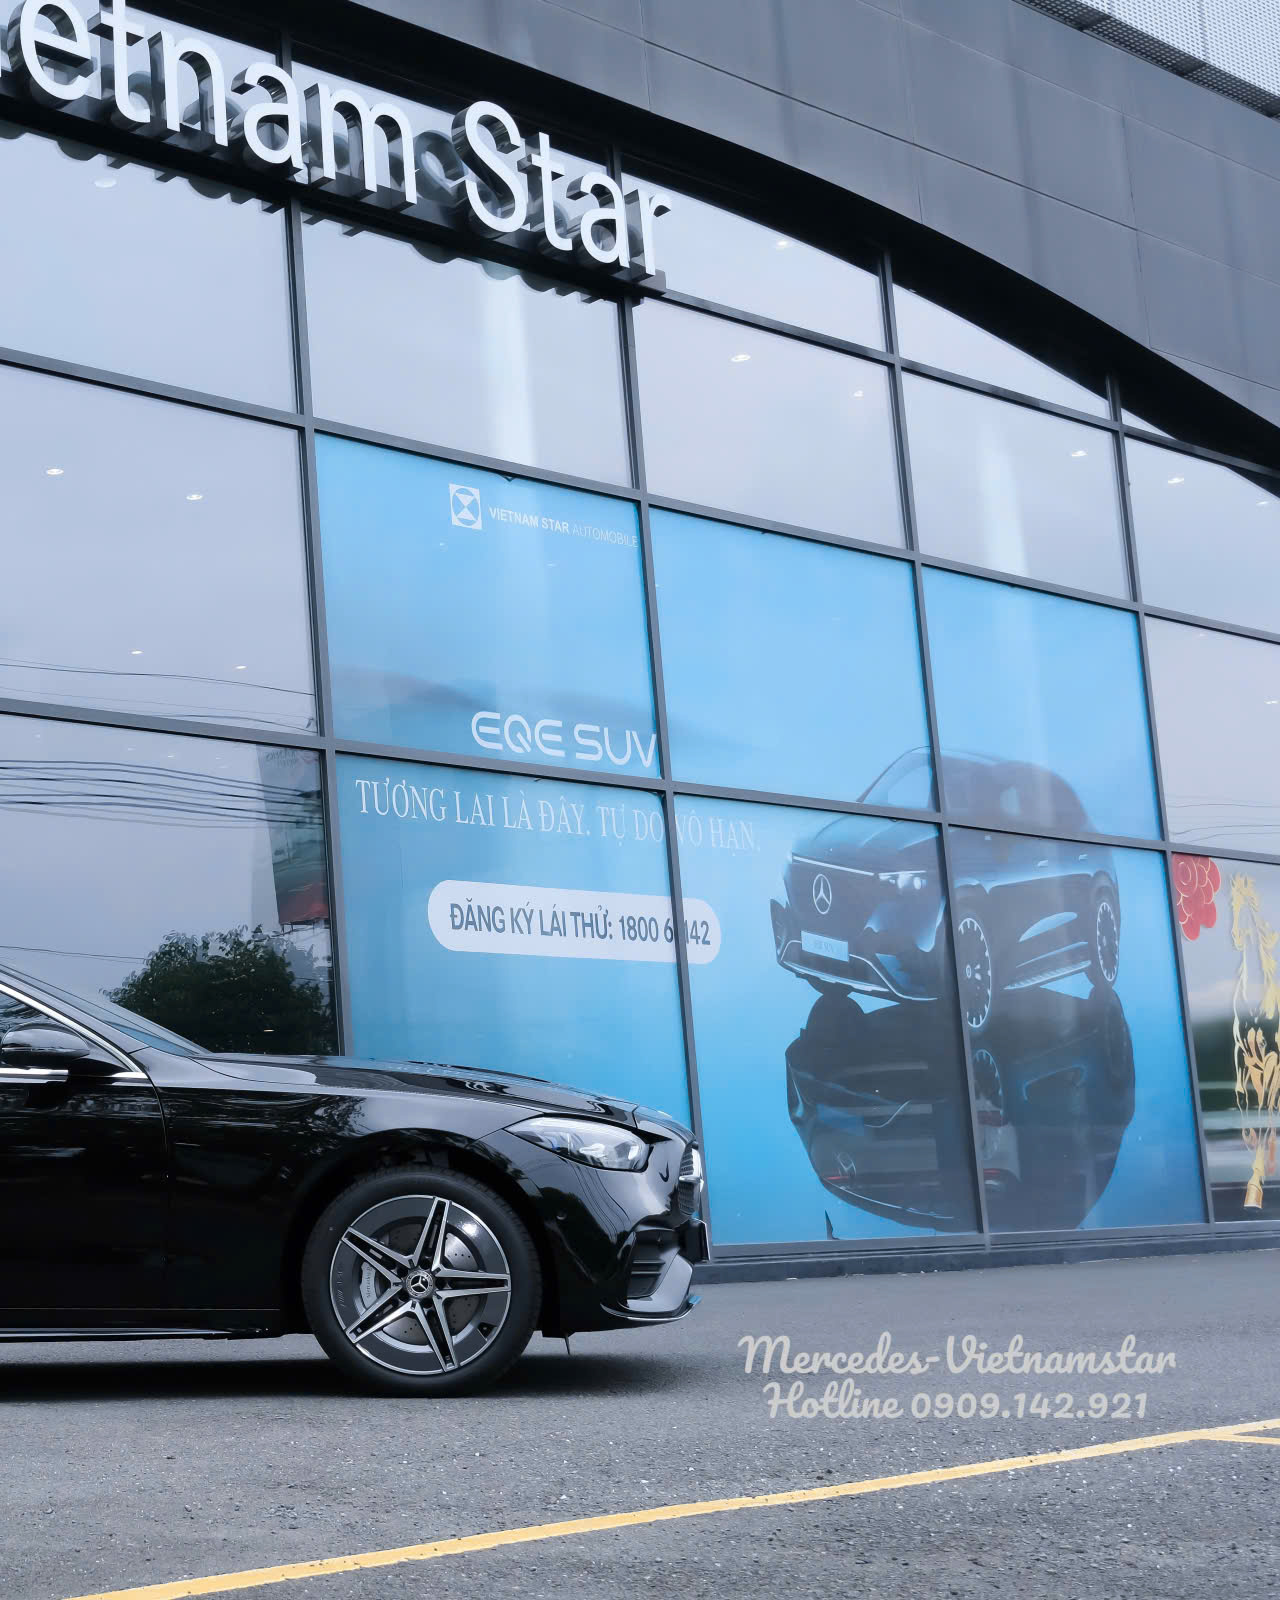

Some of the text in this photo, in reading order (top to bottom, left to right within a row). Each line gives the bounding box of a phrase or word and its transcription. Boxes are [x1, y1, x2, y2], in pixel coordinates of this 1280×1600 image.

[456, 99, 672, 277] Star
[489, 507, 639, 547] VIETNAM STAR AUTOMOBILE
[471, 711, 657, 768] EQE SUV
[355, 777, 761, 856] TƯƠNG LAI LÀ ĐÂY. TỰ DO VÔ HẠN.
[449, 897, 506, 933] ĐĂNG
[509, 901, 535, 935] KÝ
[539, 903, 567, 937] LÁI
[570, 904, 614, 940] THỬ:
[618, 915, 659, 943] 1800
